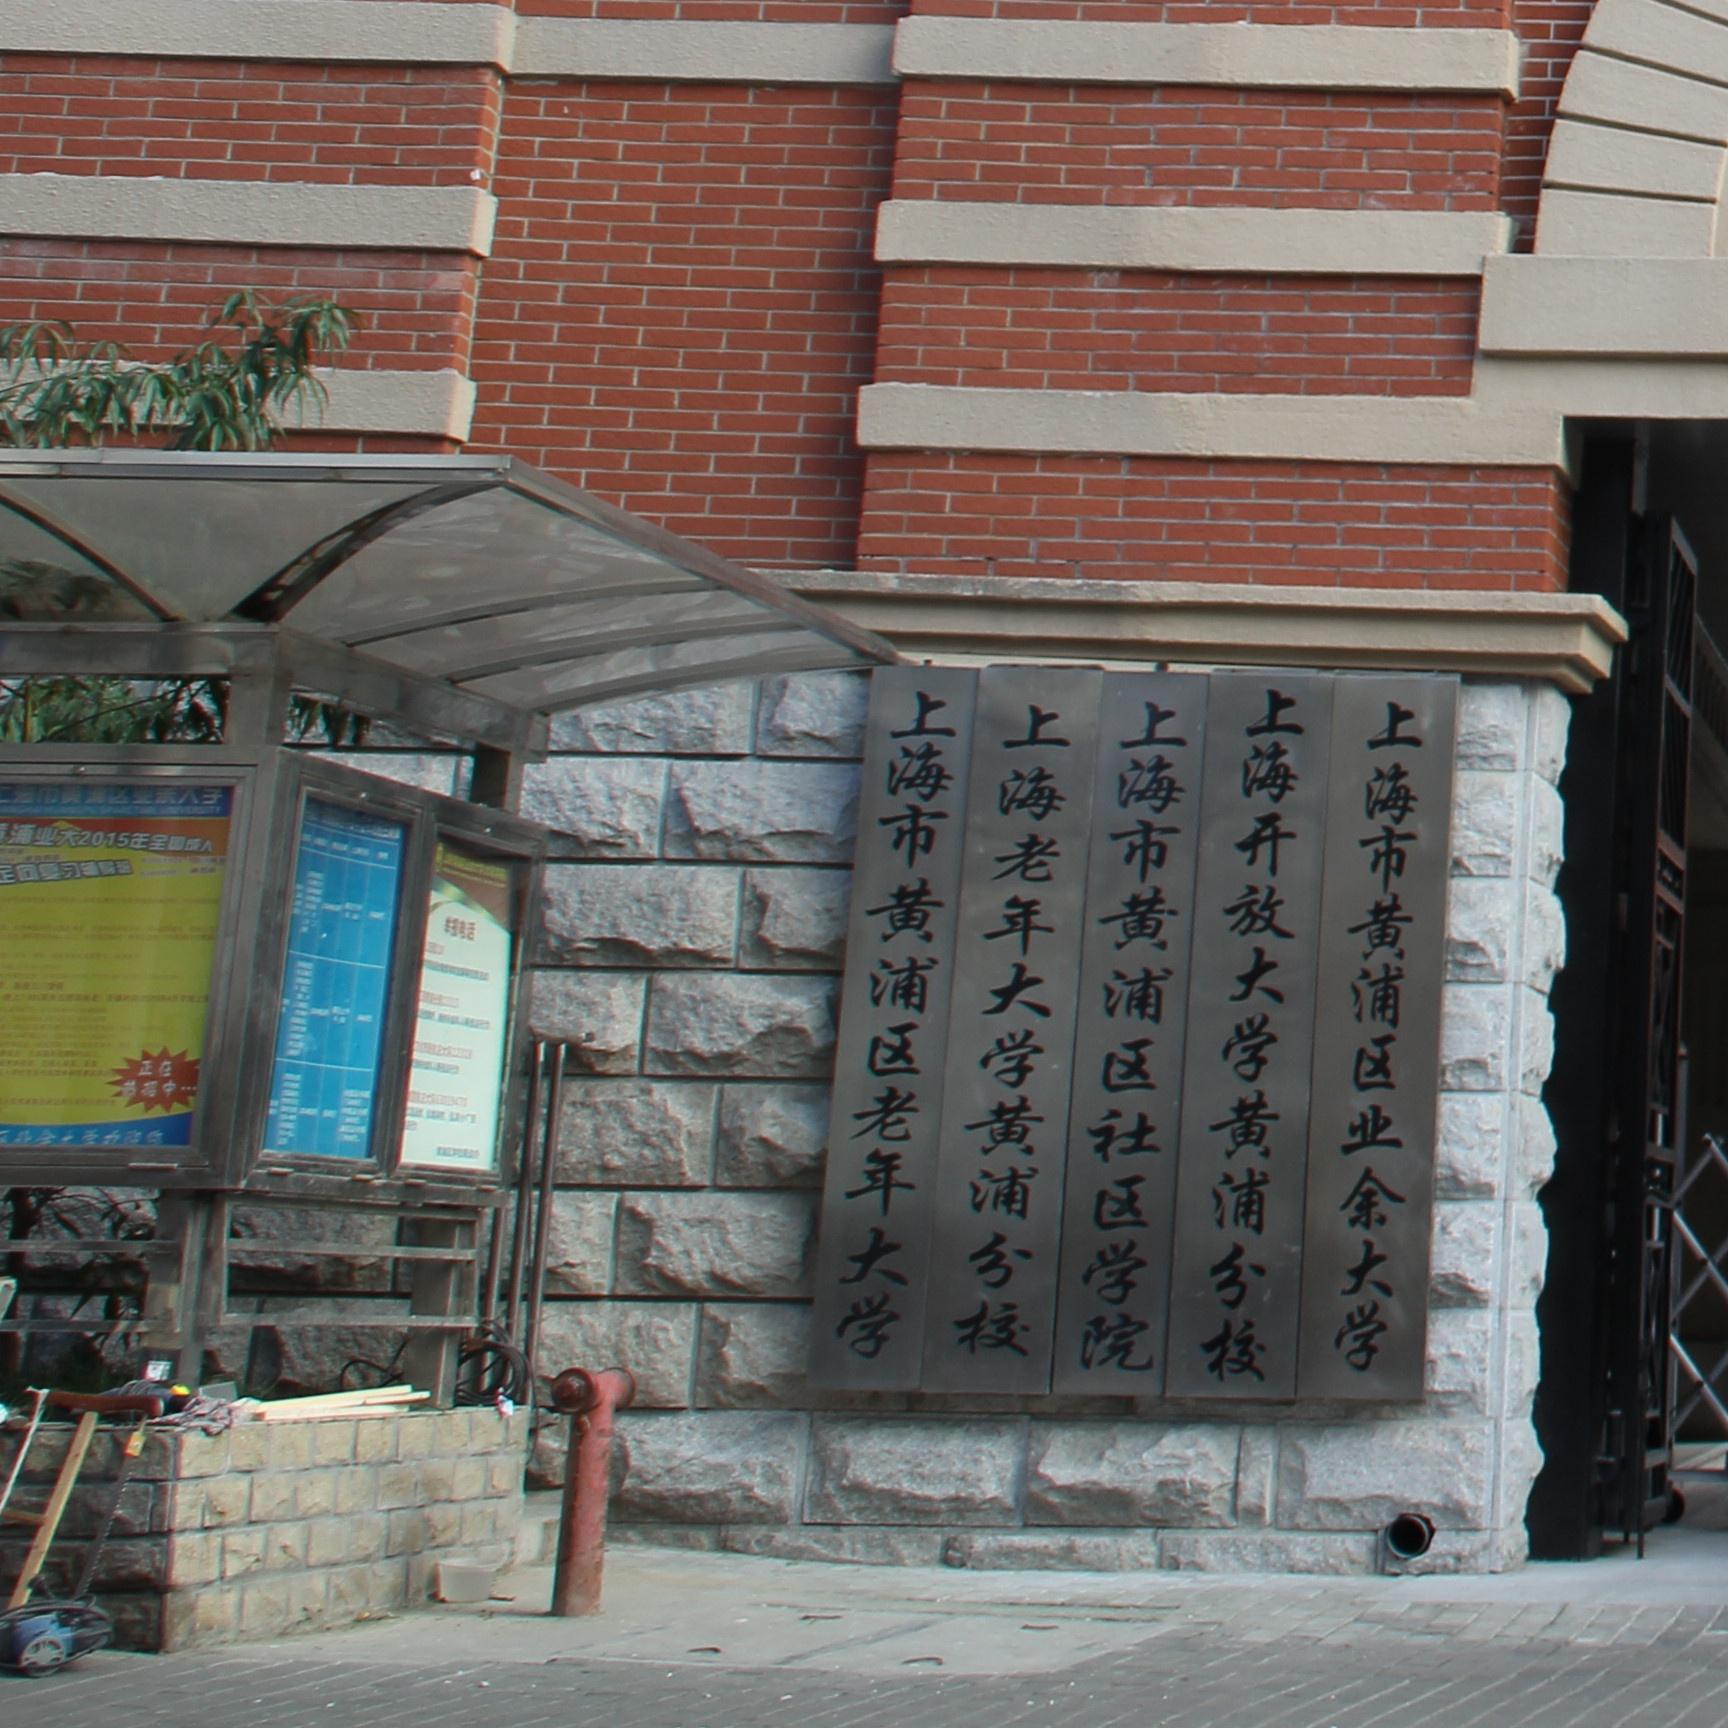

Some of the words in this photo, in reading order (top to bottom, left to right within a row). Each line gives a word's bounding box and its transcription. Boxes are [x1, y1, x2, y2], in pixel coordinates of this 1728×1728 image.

[836, 690, 955, 1360] 上海市黄浦区老年大学
[952, 704, 1071, 1357] 上海老年大学黄浦分校
[1080, 702, 1188, 1371] 上海市黄浦区社区学院
[1201, 689, 1305, 1384] 上海开放大学黄浦分校
[1334, 702, 1424, 1373] 上海市黄浦区业余大学
